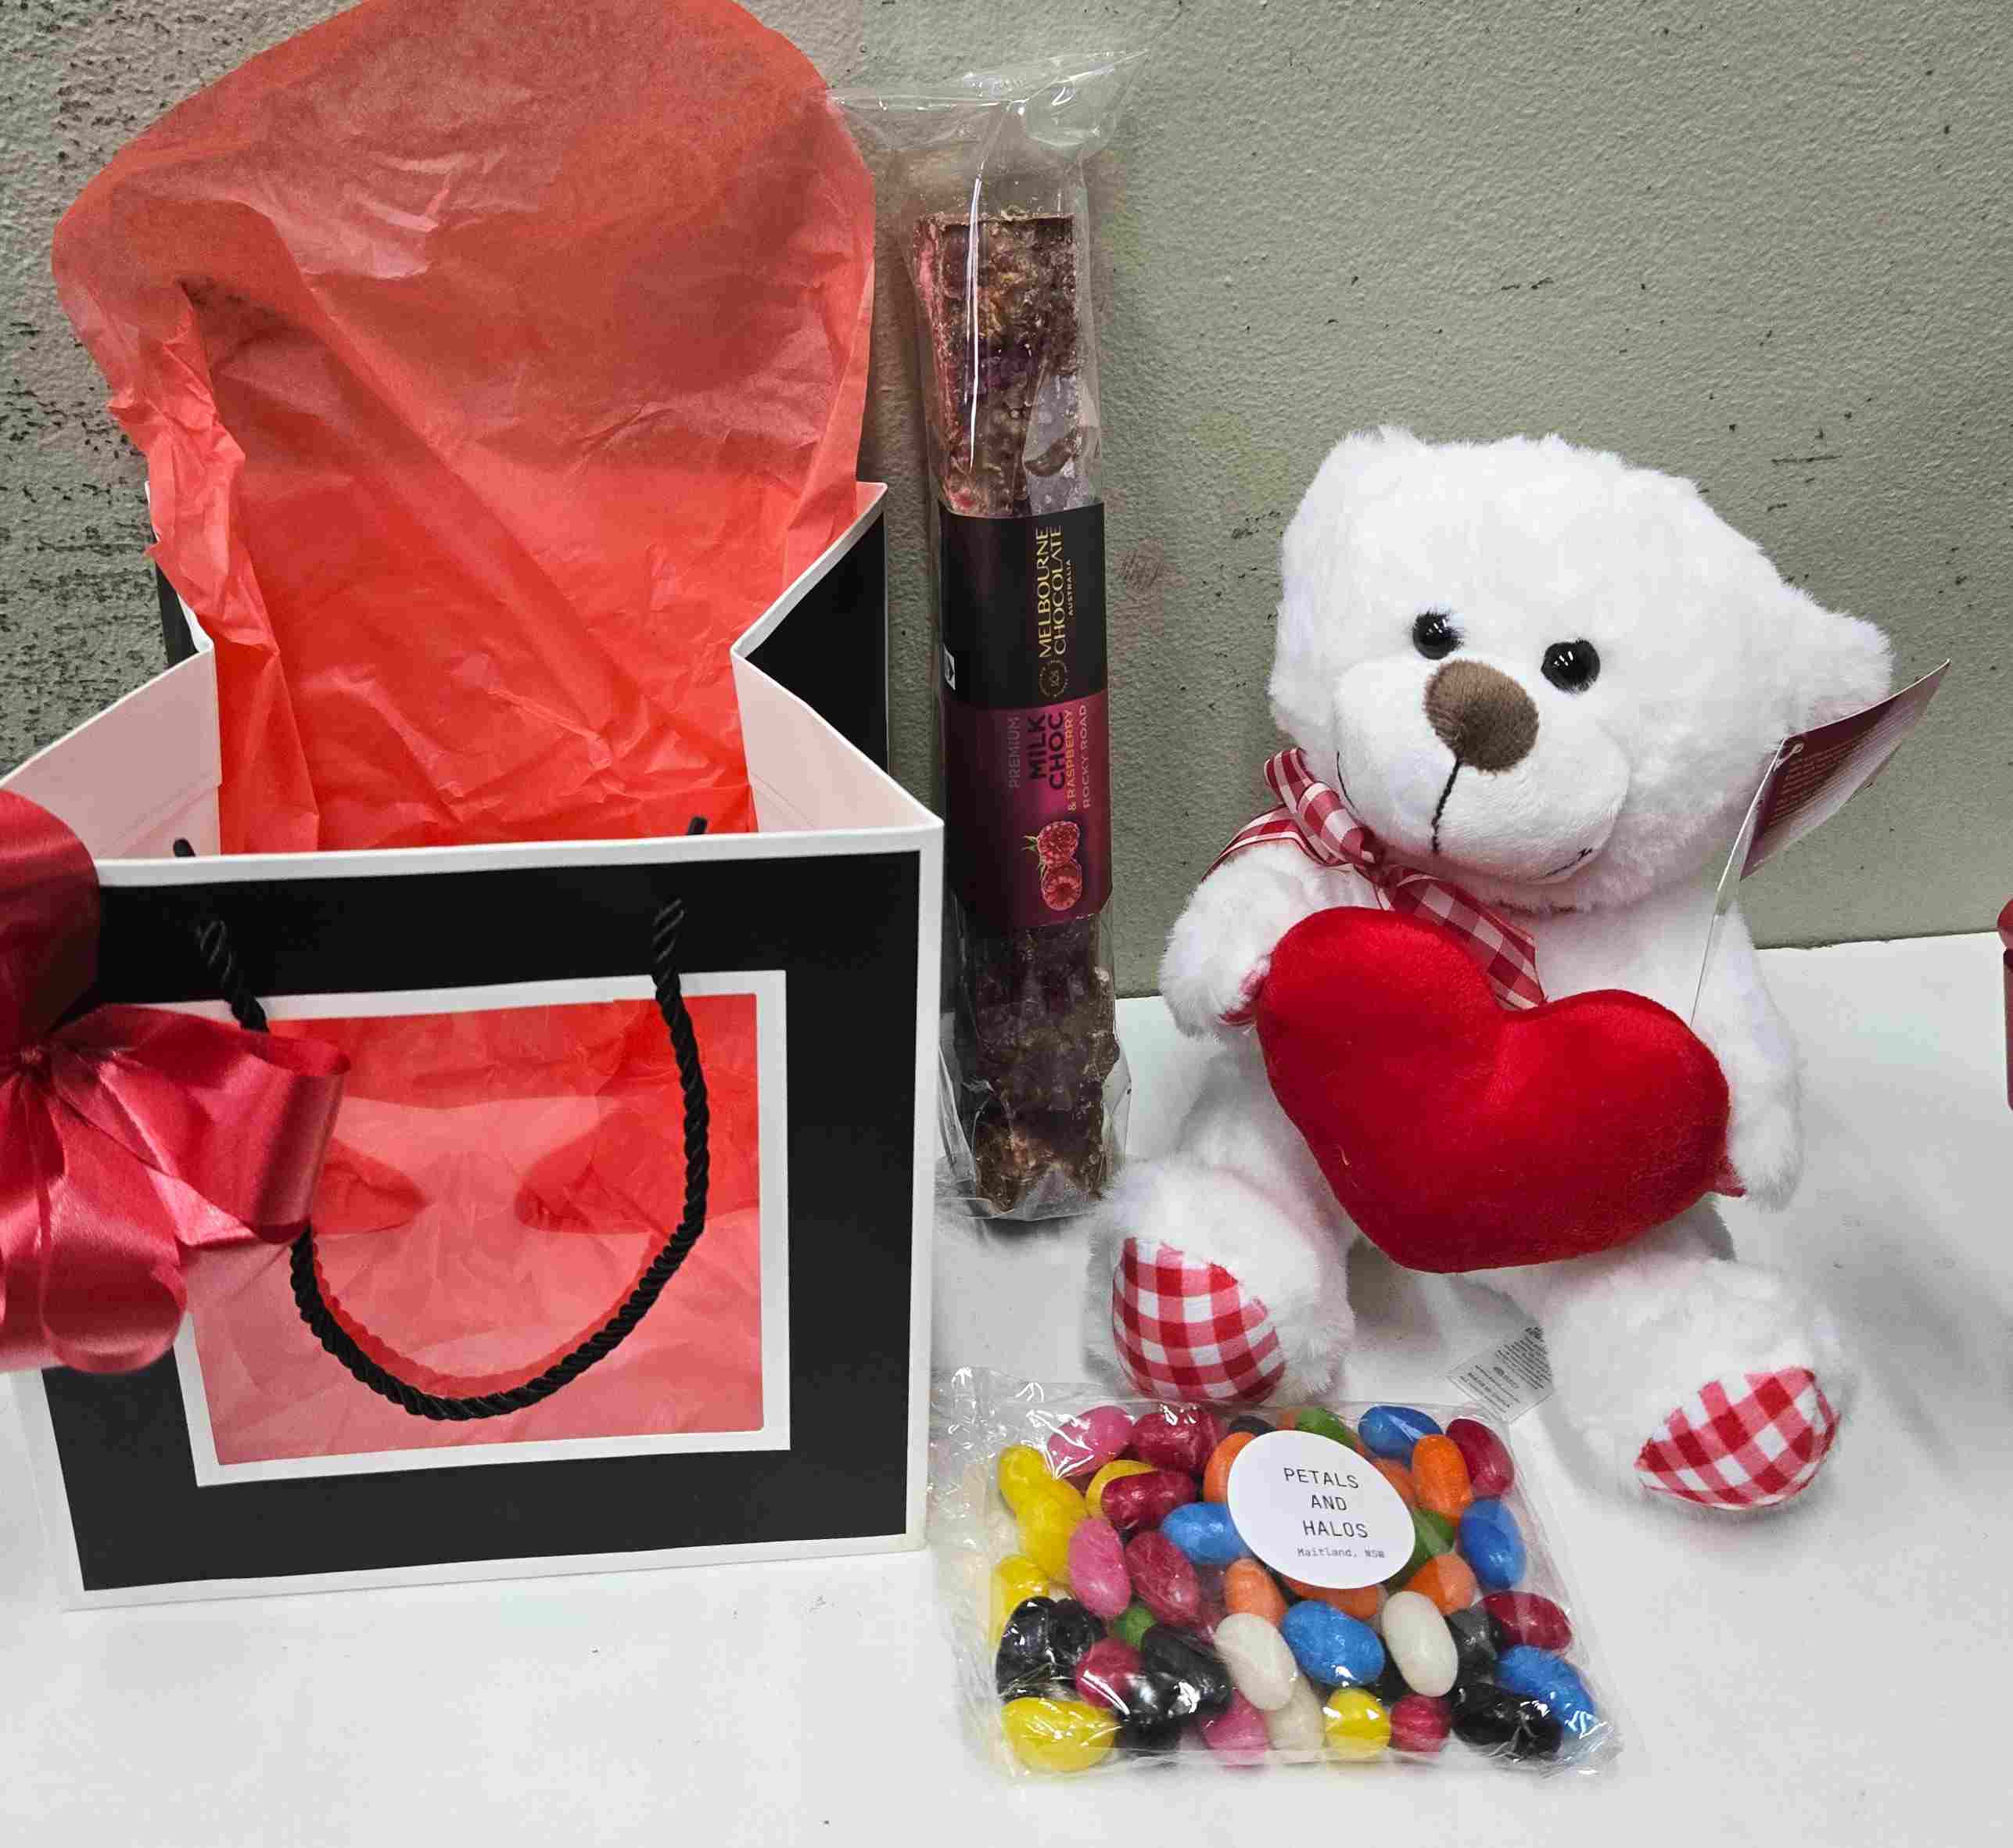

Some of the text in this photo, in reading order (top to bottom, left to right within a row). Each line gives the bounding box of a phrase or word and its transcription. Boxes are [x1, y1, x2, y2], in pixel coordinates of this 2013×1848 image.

[1036, 526, 1052, 658] MELBOURNE
[1051, 525, 1066, 655] CHOCOLATE
[1065, 559, 1075, 615] AUSTRALIA
[1007, 716, 1021, 788] PREMIUM
[1027, 713, 1046, 780] MILK
[1047, 712, 1065, 789] CHOC
[1064, 709, 1077, 811] & RASPBERRY
[1078, 705, 1091, 808] ROCKY ROAD
[1283, 1467, 1359, 1489] PETALS
[1311, 1494, 1347, 1511] AND
[1297, 1547, 1357, 1557] Maitland,
[1303, 1520, 1369, 1538] HALOS
